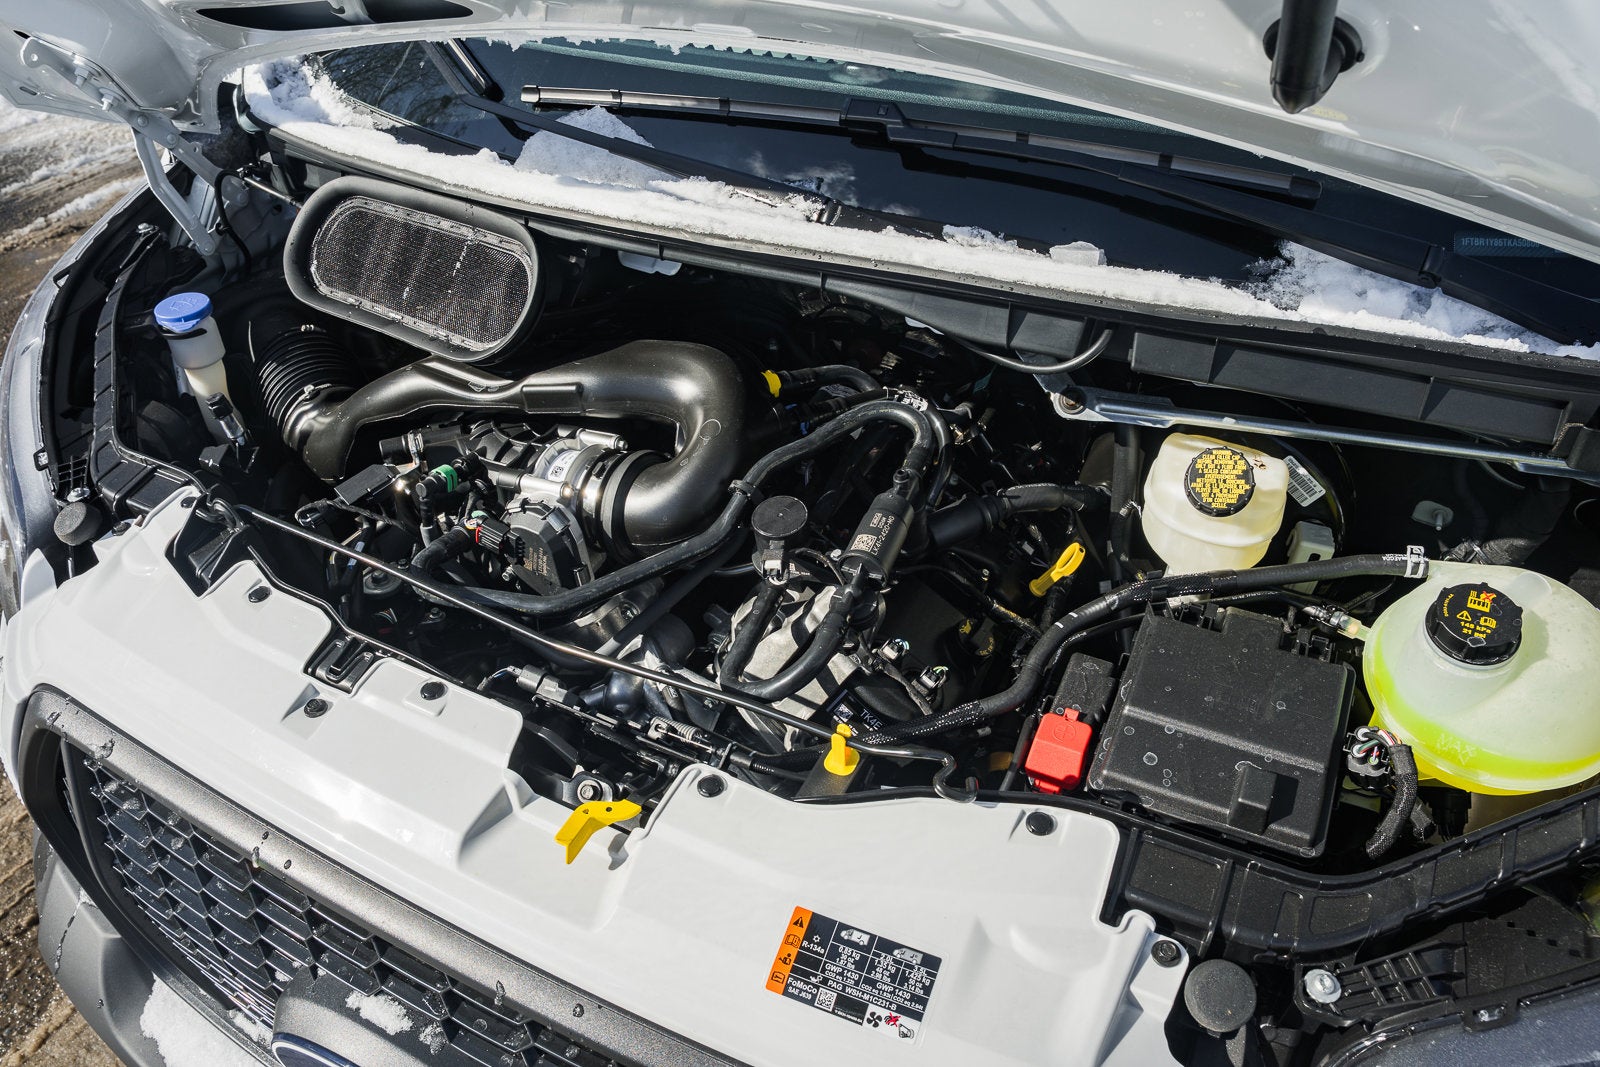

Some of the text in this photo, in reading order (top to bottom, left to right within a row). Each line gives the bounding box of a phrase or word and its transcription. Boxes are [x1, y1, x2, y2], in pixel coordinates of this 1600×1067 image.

[1476, 626, 1492, 634] kPa
[801, 940, 825, 954] R-134a
[850, 950, 860, 960] kg
[824, 962, 859, 980] GWP 1430
[886, 963, 896, 973] kg
[786, 977, 818, 994] FoMoCo
[826, 979, 843, 990] PAG
[920, 976, 931, 986] kg
[787, 986, 800, 995] SAE
[875, 981, 911, 999] GWP 1430
